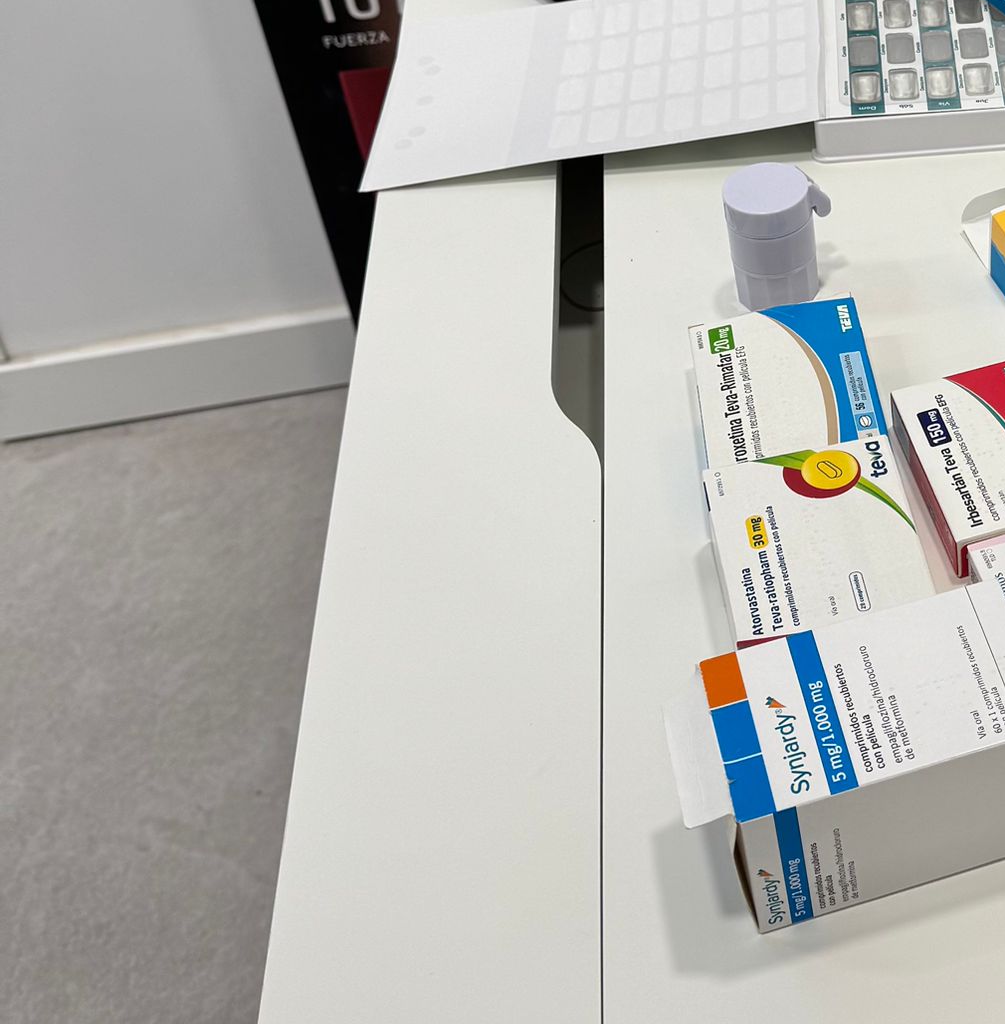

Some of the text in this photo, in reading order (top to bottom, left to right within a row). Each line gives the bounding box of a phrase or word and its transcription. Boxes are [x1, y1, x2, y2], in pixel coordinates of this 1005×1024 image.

[323, 30, 391, 48] FUERZA
[836, 304, 853, 333] TEVA
[733, 345, 746, 359] EFG
[738, 358, 752, 382] película
[713, 327, 749, 463] roxetina Teva-Rimafar 20 mg
[743, 382, 753, 394] con
[745, 394, 759, 429] recubiertos
[864, 440, 888, 478] teva
[927, 410, 984, 528] Irbesartán Teva 150 mg
[934, 394, 1001, 522] comprimidos recubiertos con película EFG
[750, 516, 762, 532] mg
[752, 534, 765, 547] 30
[765, 505, 801, 627] comprimidos recubiertos con película
[741, 567, 764, 636] Atorvastatina
[828, 596, 837, 607] oral
[853, 574, 865, 603] comprimidos
[956, 625, 976, 663] recubiertos
[859, 645, 911, 764] empagliflozina/hidrocloruro
[971, 663, 1002, 710] comprimidos
[808, 680, 847, 782] 5 mg/1.000 mg
[834, 663, 874, 773] comprimidos recubiertos
[881, 694, 915, 760] de metformina
[970, 710, 982, 725] oral
[992, 723, 1003, 734] 60
[861, 714, 886, 769] con película
[788, 858, 801, 873] mg
[810, 842, 827, 910] comprimidos recubiertos
[788, 873, 807, 910] mg/1.000
[828, 895, 836, 906] con
[851, 891, 859, 899] de
